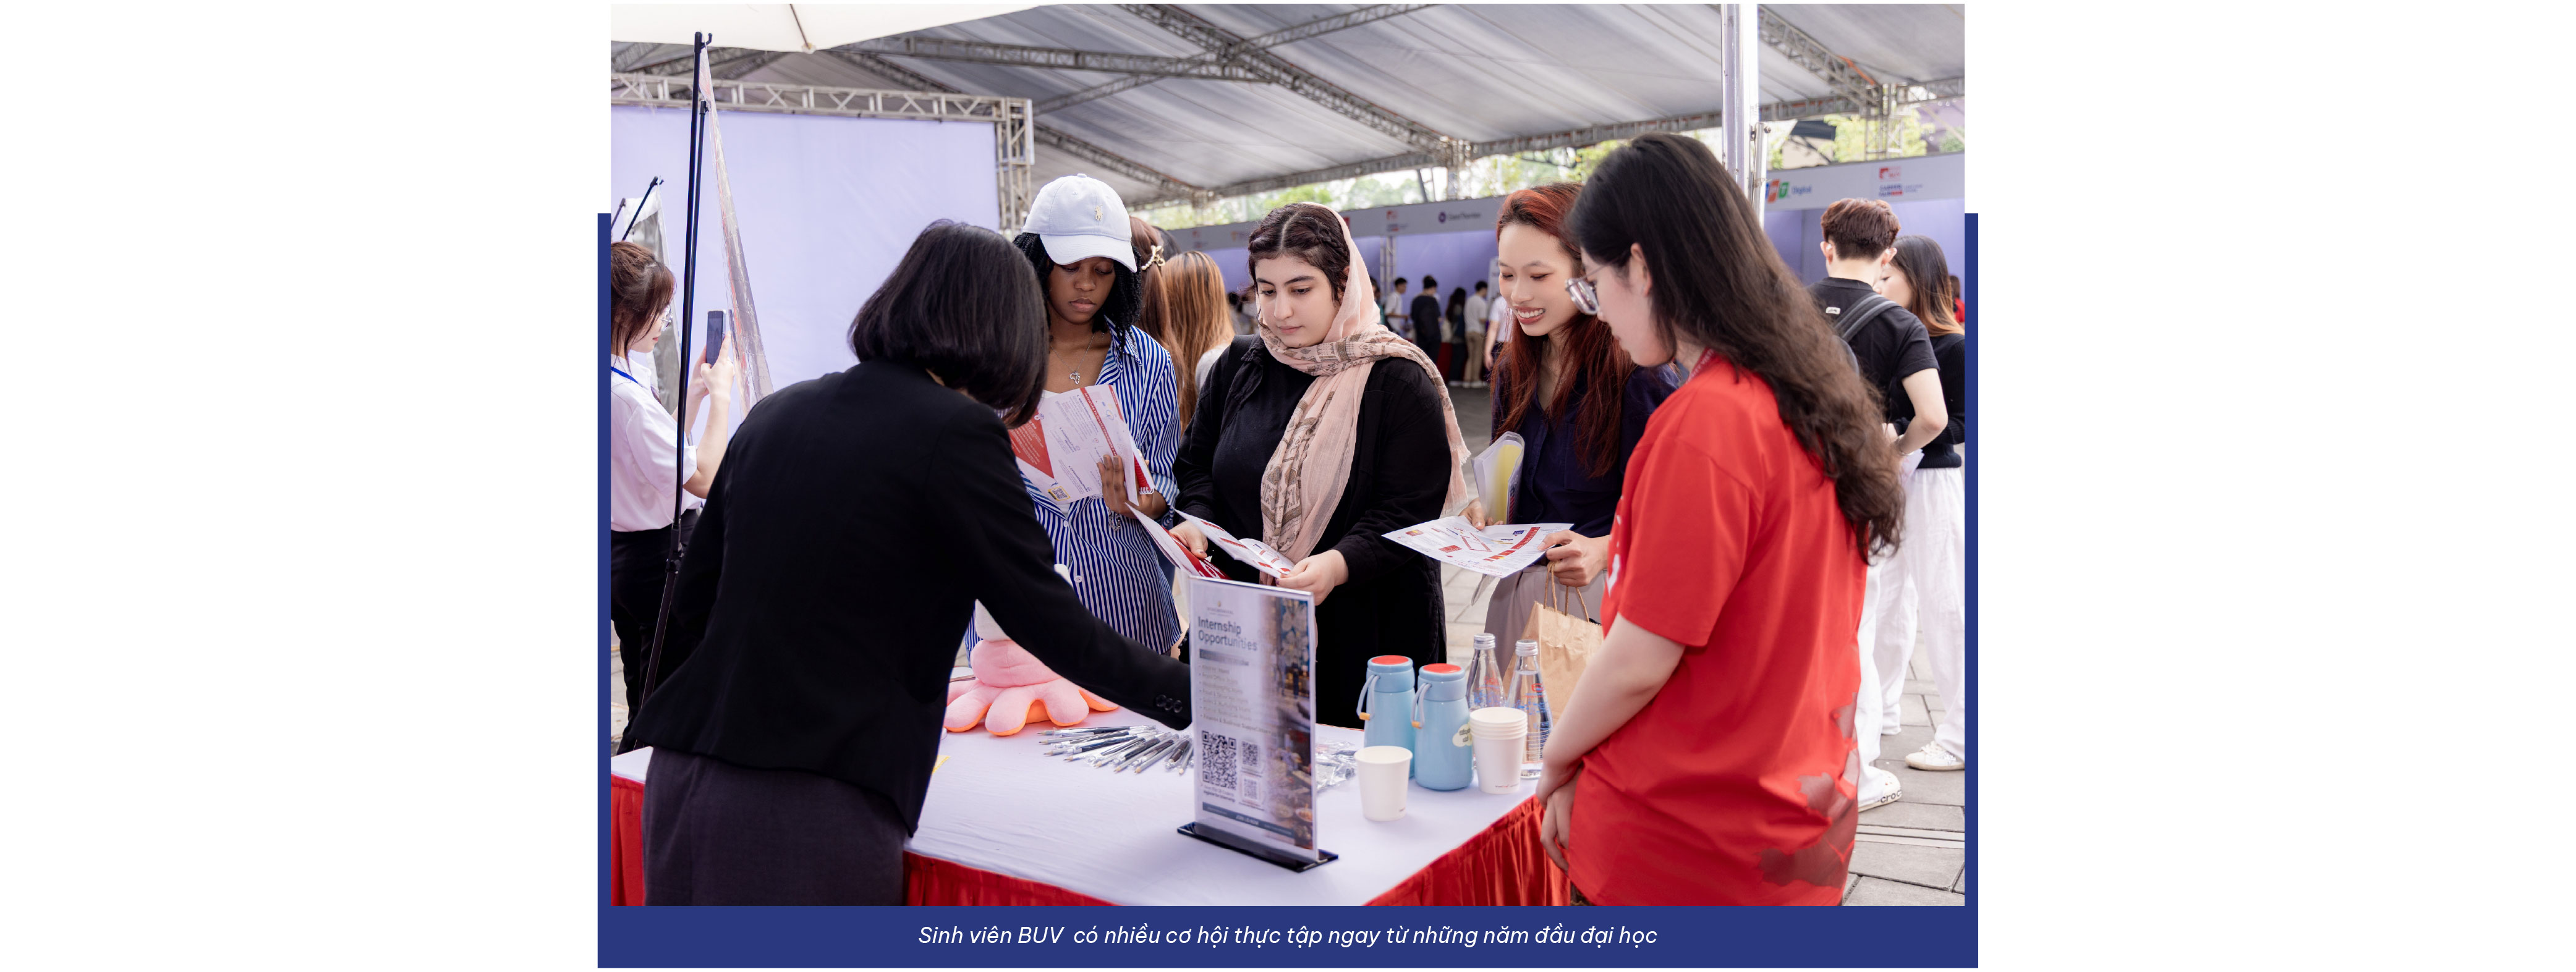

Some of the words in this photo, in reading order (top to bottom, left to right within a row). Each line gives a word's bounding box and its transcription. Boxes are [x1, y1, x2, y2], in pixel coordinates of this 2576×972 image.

[1792, 185, 1812, 195] Digital
[1198, 616, 1241, 636] Internship
[1199, 630, 1257, 651] Opportunities
[1881, 788, 1903, 803] croc
